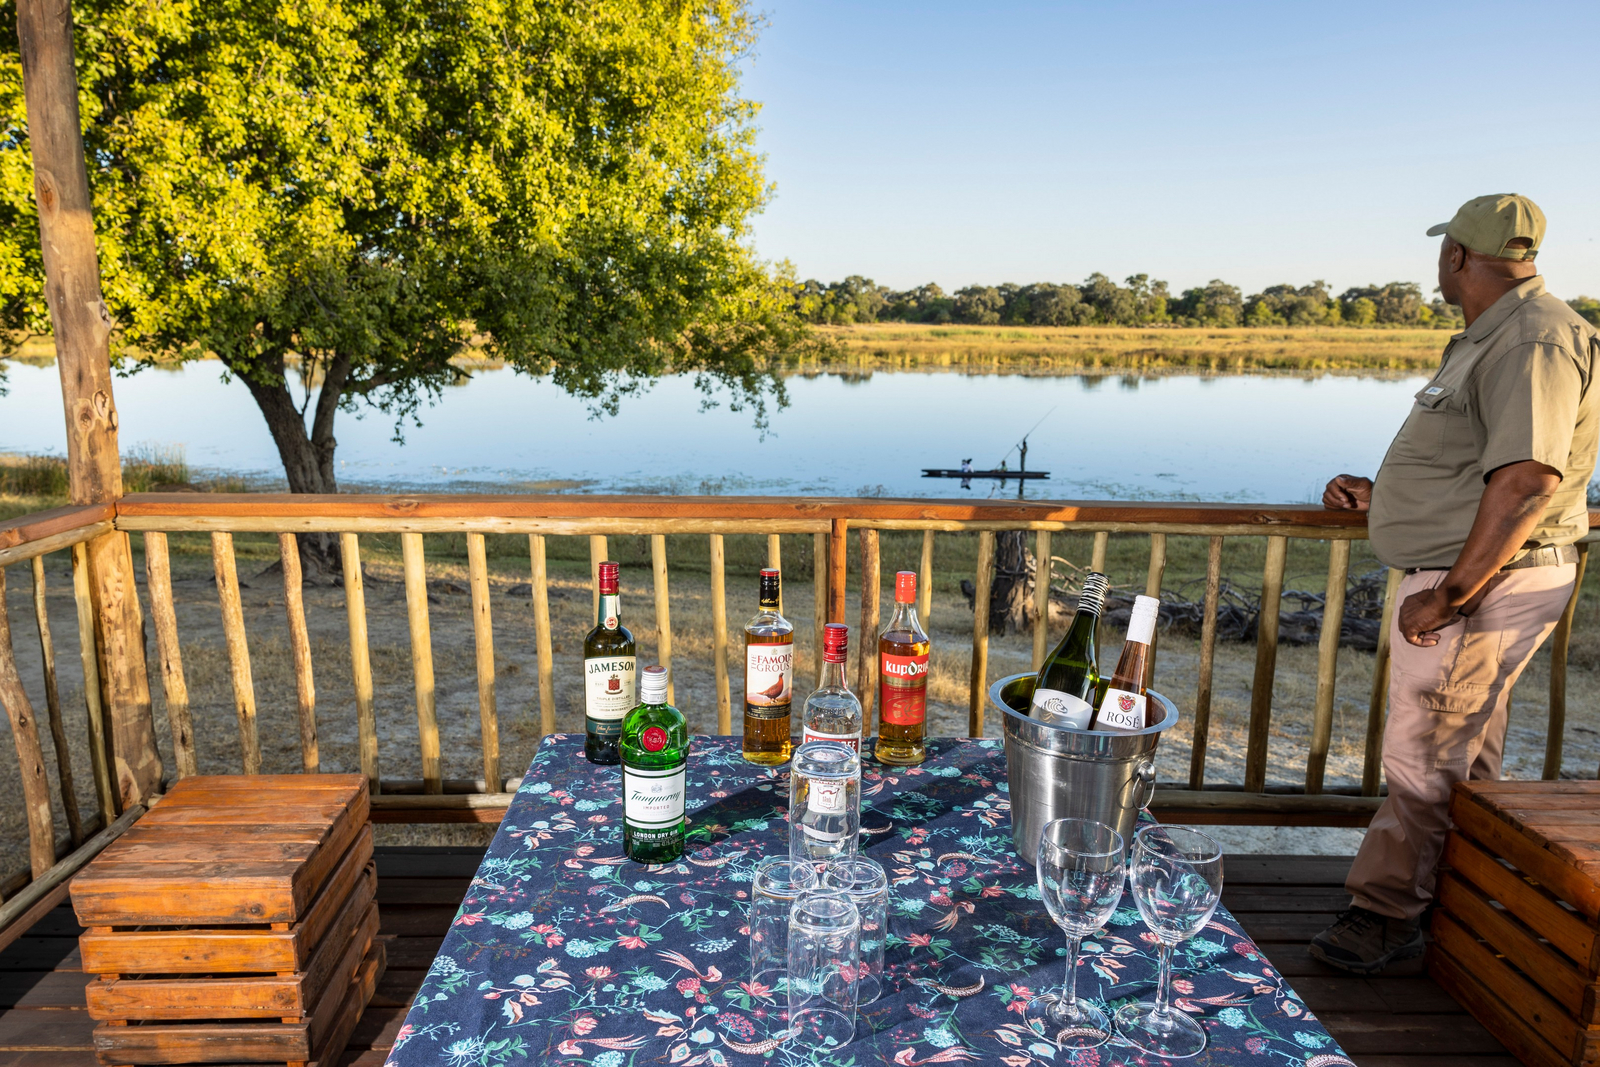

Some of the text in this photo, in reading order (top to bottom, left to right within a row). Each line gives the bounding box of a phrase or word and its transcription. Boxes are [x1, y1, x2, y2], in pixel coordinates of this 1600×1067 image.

[589, 661, 634, 674] JAMESON
[1106, 711, 1139, 729] ROSÉ
[631, 790, 681, 805] Tanqueray
[633, 831, 656, 839] LONDON
